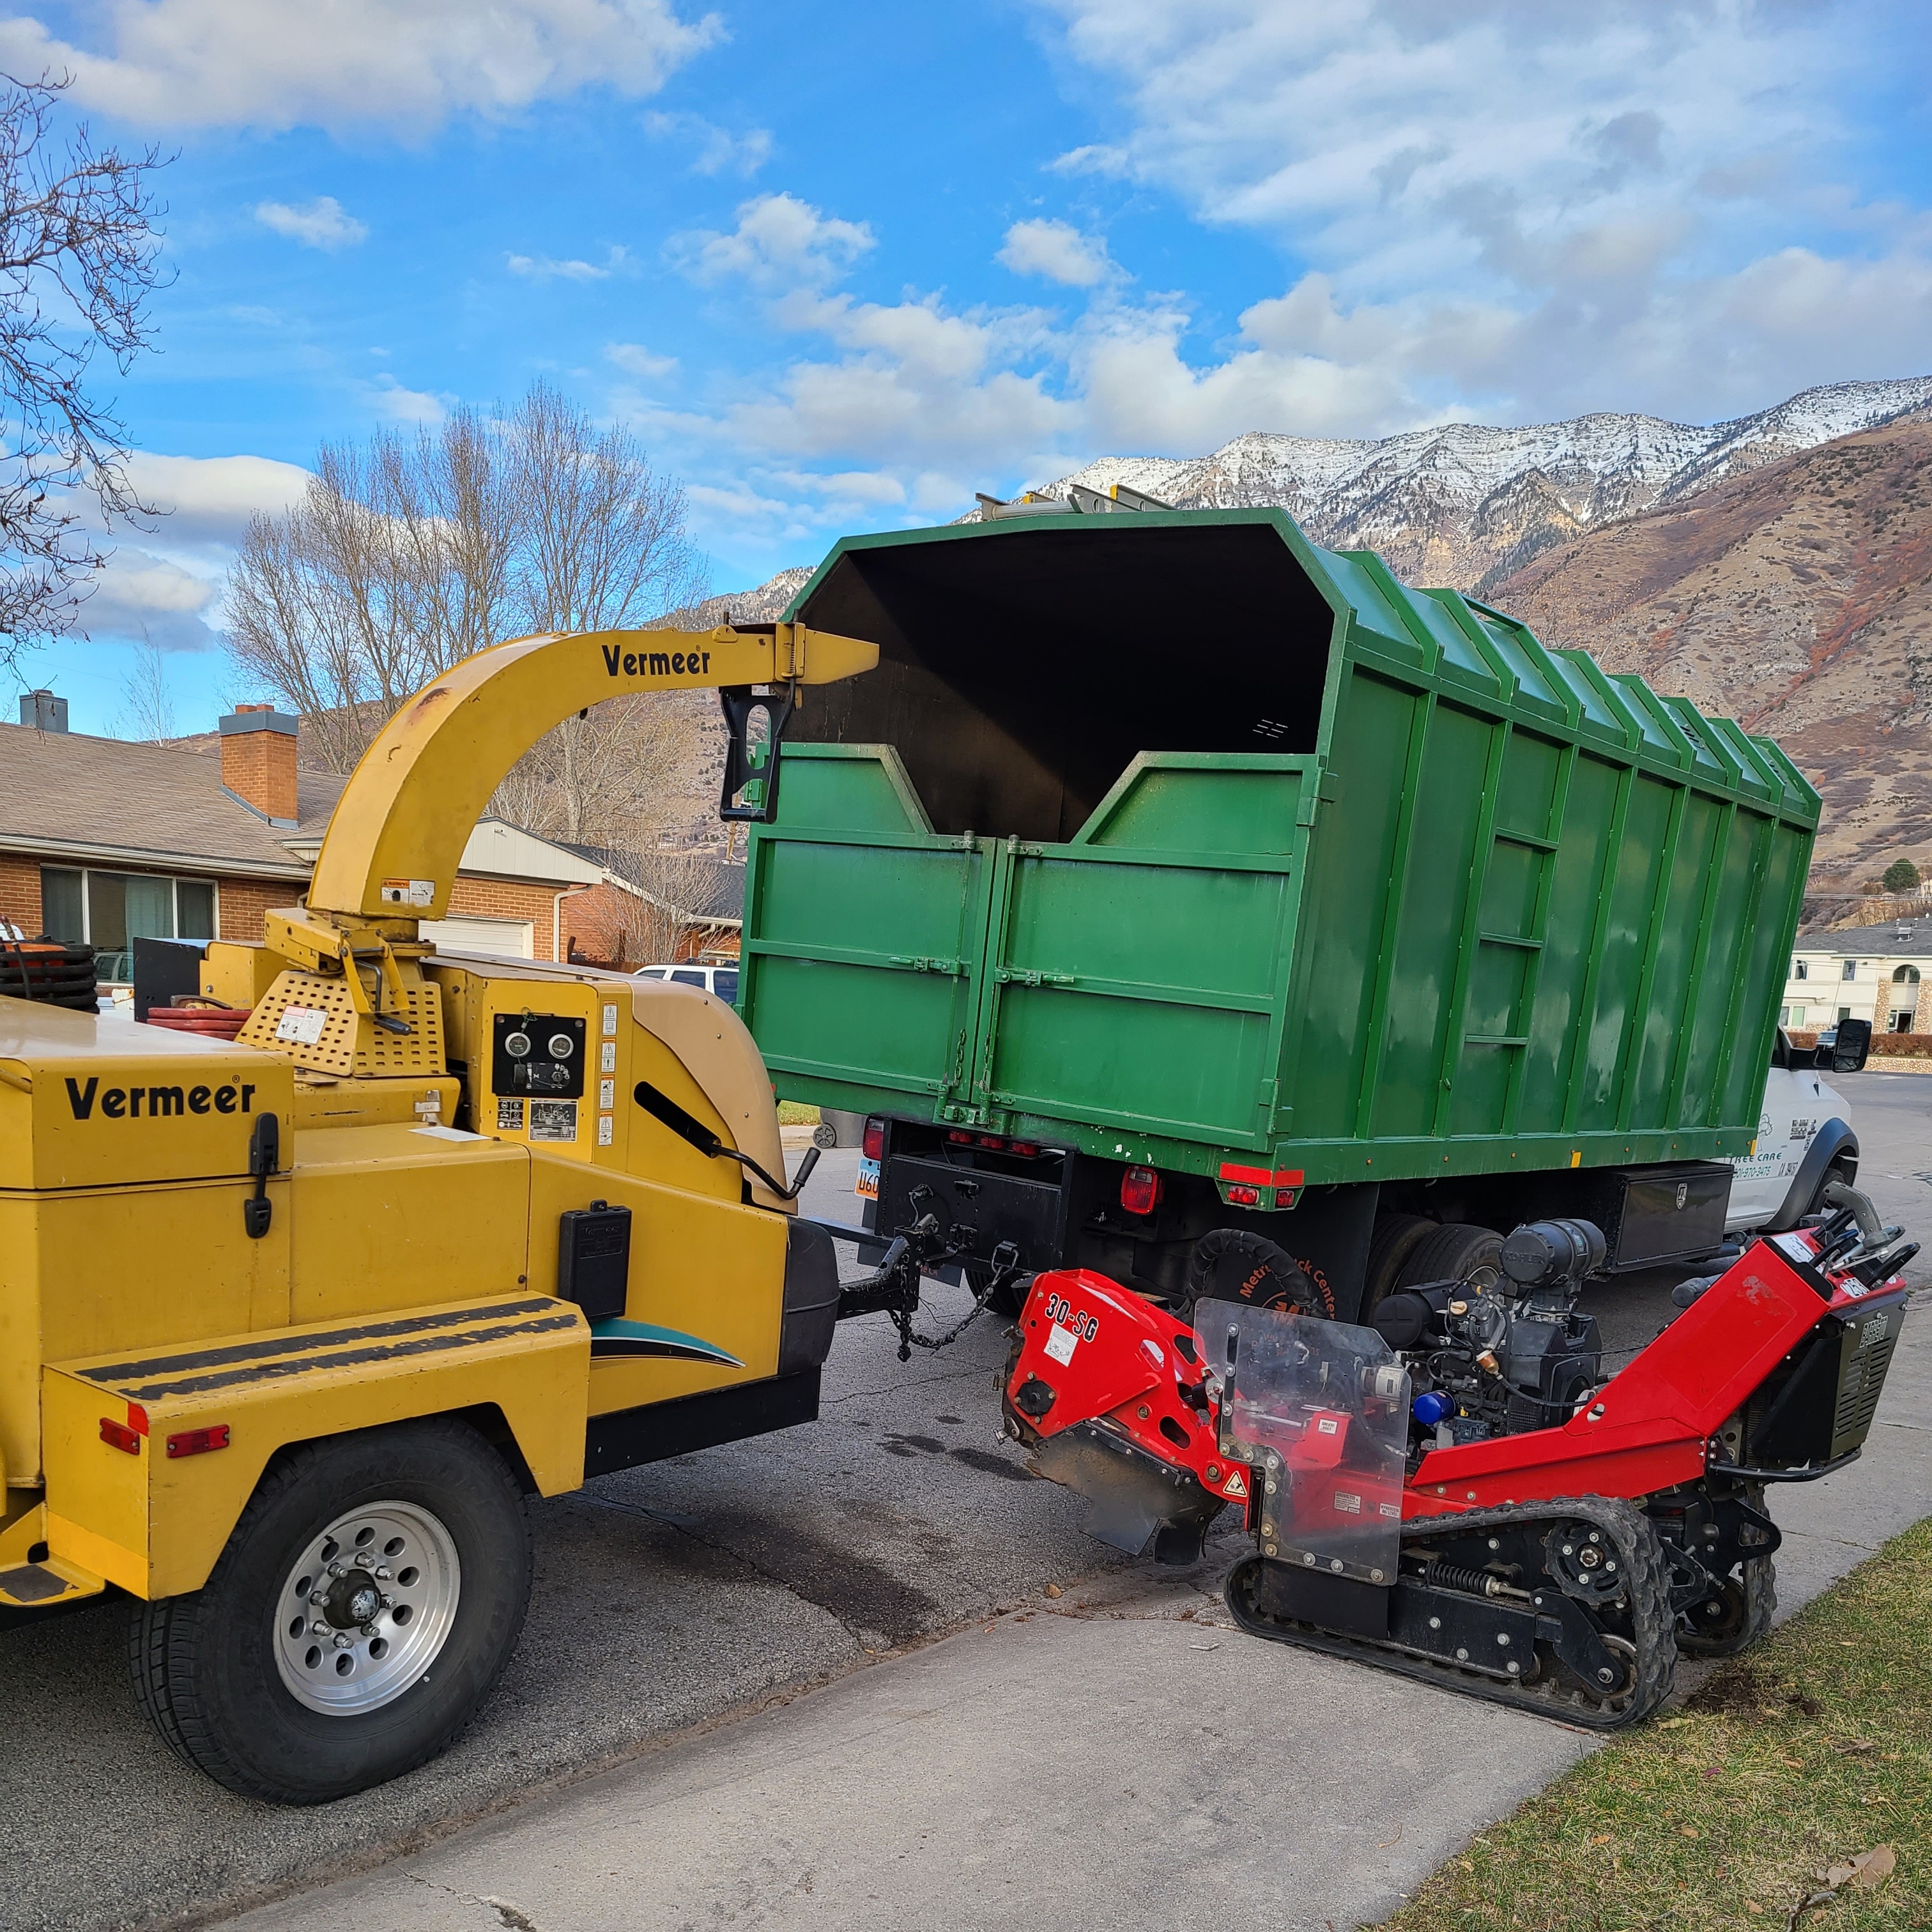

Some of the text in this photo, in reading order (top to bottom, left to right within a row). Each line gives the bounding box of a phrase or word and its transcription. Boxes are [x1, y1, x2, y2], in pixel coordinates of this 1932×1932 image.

[601, 645, 710, 677] Vermeer
[65, 1077, 256, 1121] Vermeer
[1757, 1152, 1782, 1162] CARE
[1313, 1269, 1335, 1320] Center
[1045, 1292, 1099, 1343] 30-SG
